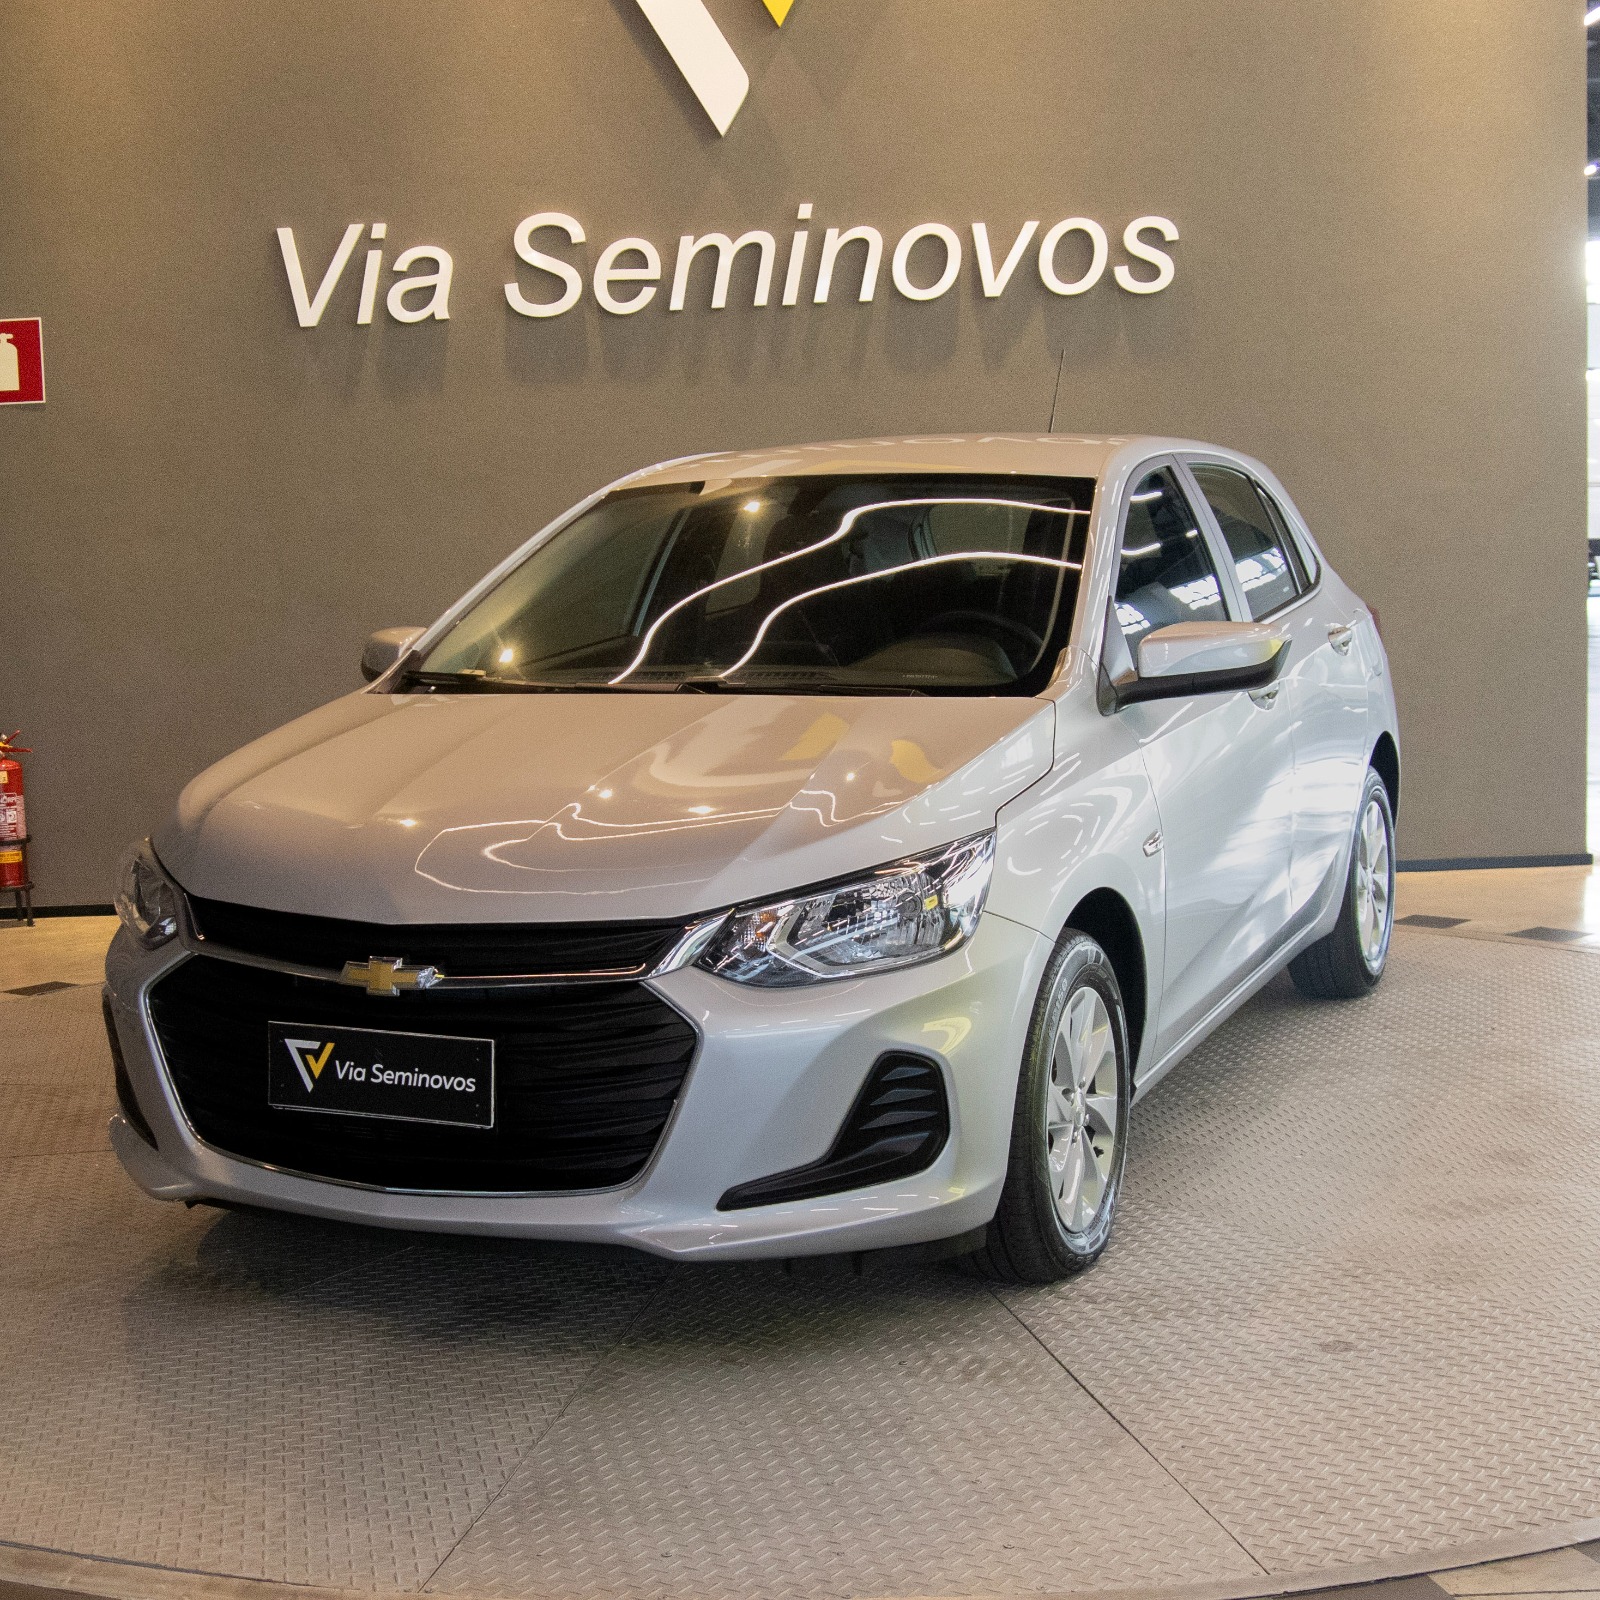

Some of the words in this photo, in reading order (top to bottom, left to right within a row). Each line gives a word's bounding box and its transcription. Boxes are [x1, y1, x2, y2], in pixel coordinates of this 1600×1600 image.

[277, 222, 454, 327] Via
[504, 203, 1180, 318] Seminovos
[335, 1060, 366, 1082] Via
[371, 1063, 476, 1092] Seminovos
